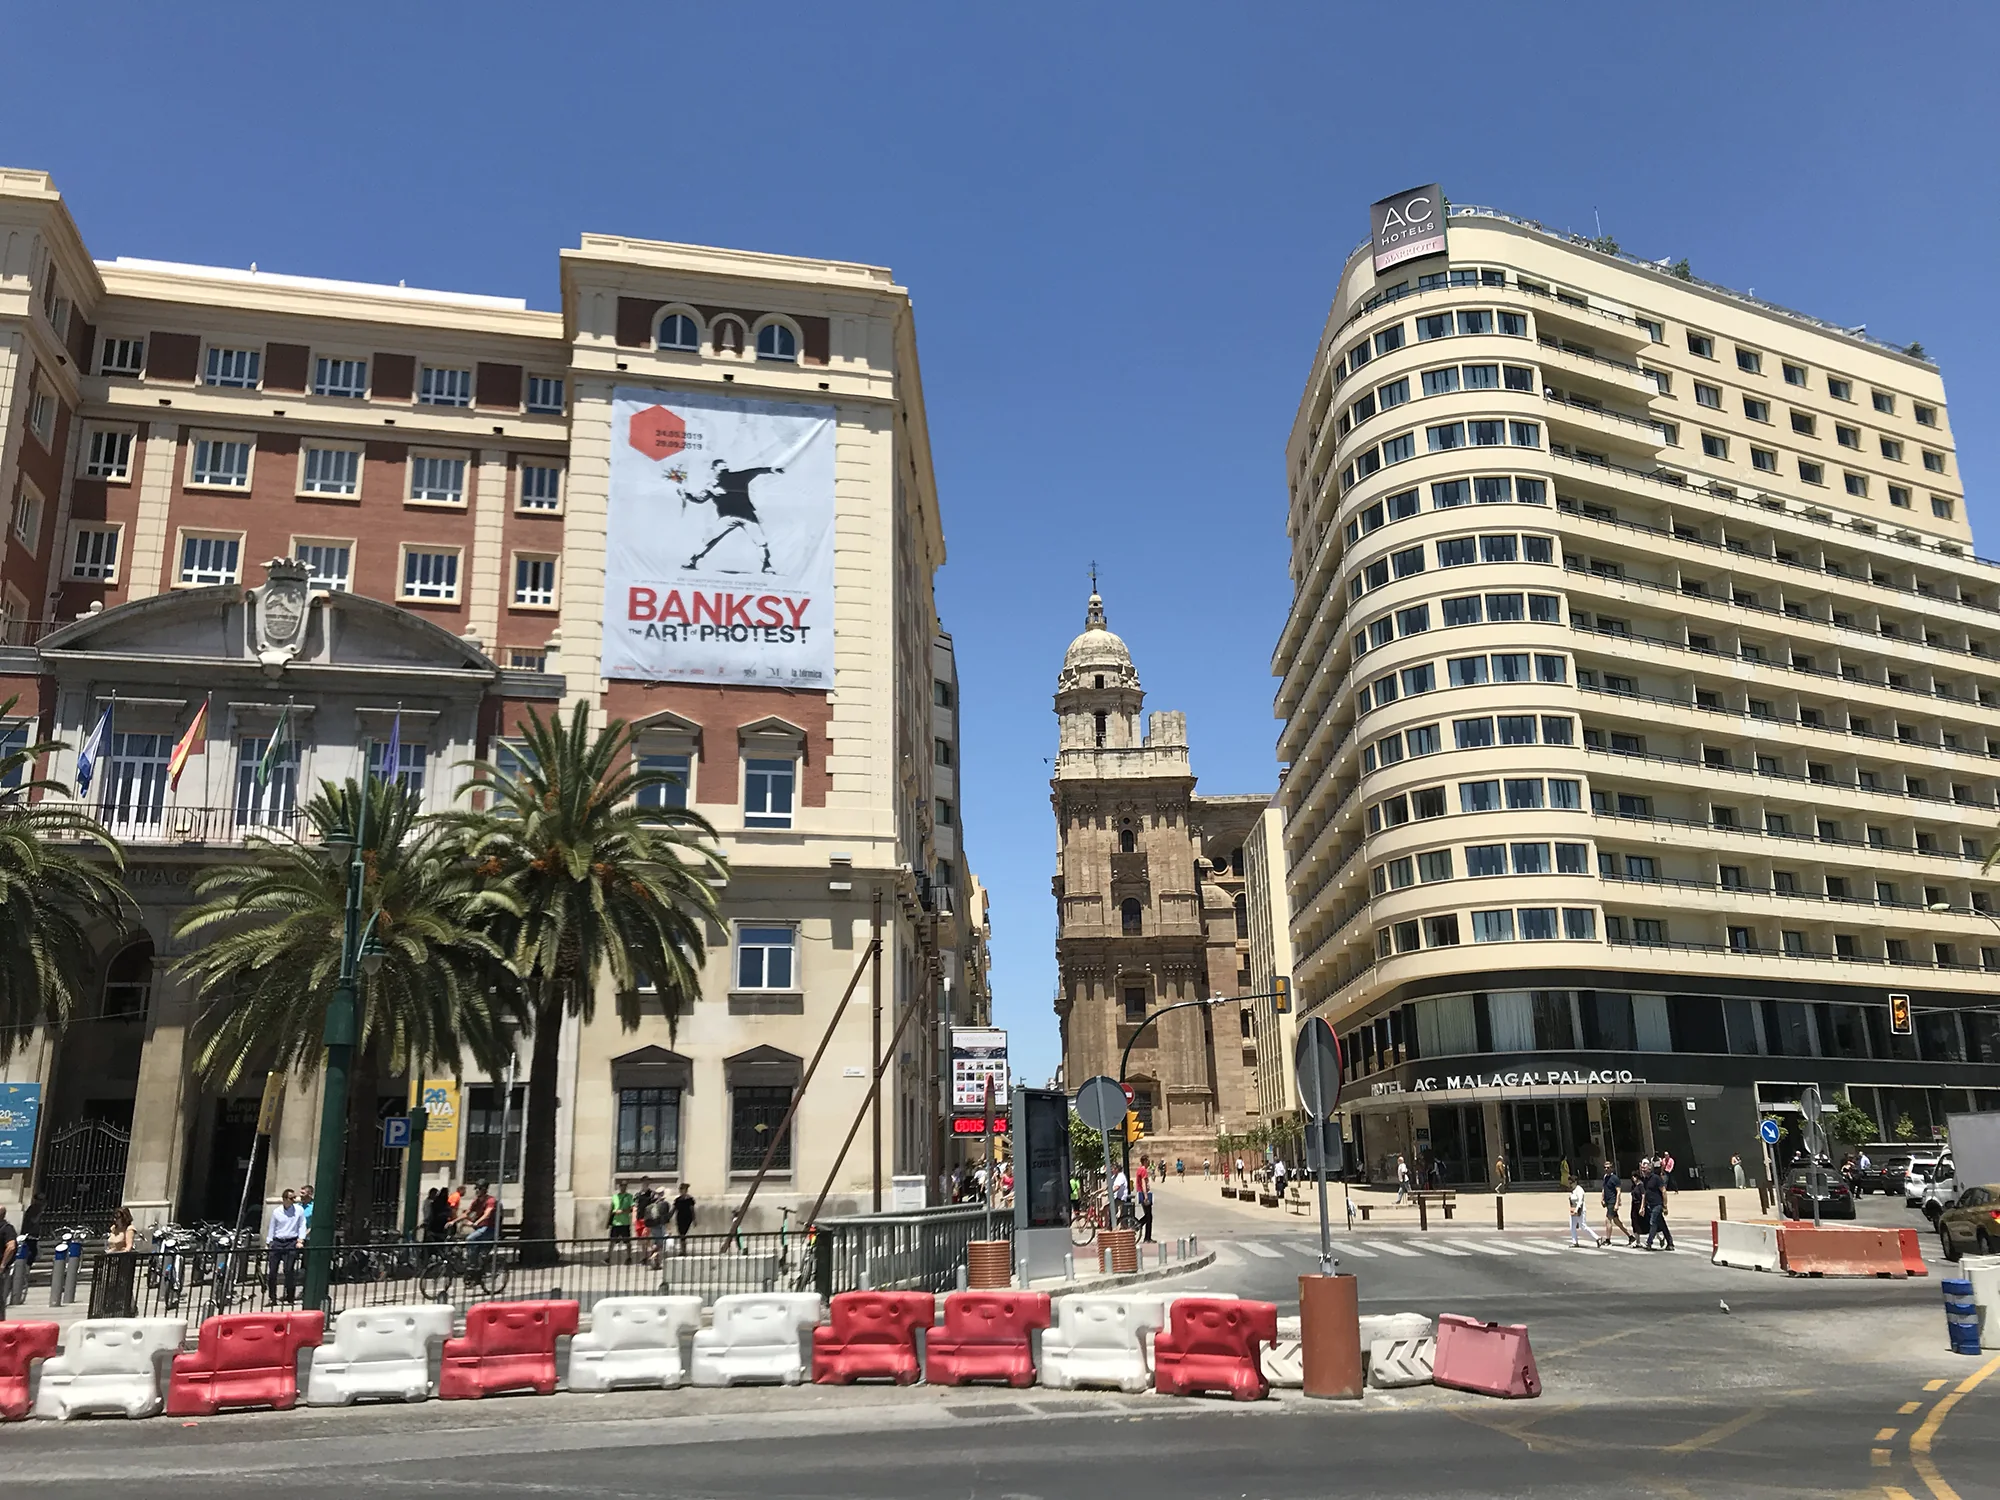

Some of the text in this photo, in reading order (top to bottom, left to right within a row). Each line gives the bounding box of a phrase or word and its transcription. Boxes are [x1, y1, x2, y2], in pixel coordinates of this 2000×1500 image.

[1381, 197, 1434, 235] AC
[1381, 222, 1435, 246] HOTELS
[628, 586, 811, 630] BANKSY
[644, 623, 692, 642] ART
[700, 624, 811, 644] PROTEST
[1370, 1070, 1633, 1097] HOTEL AC MALAGA PALACIO
[388, 1121, 406, 1144] P
